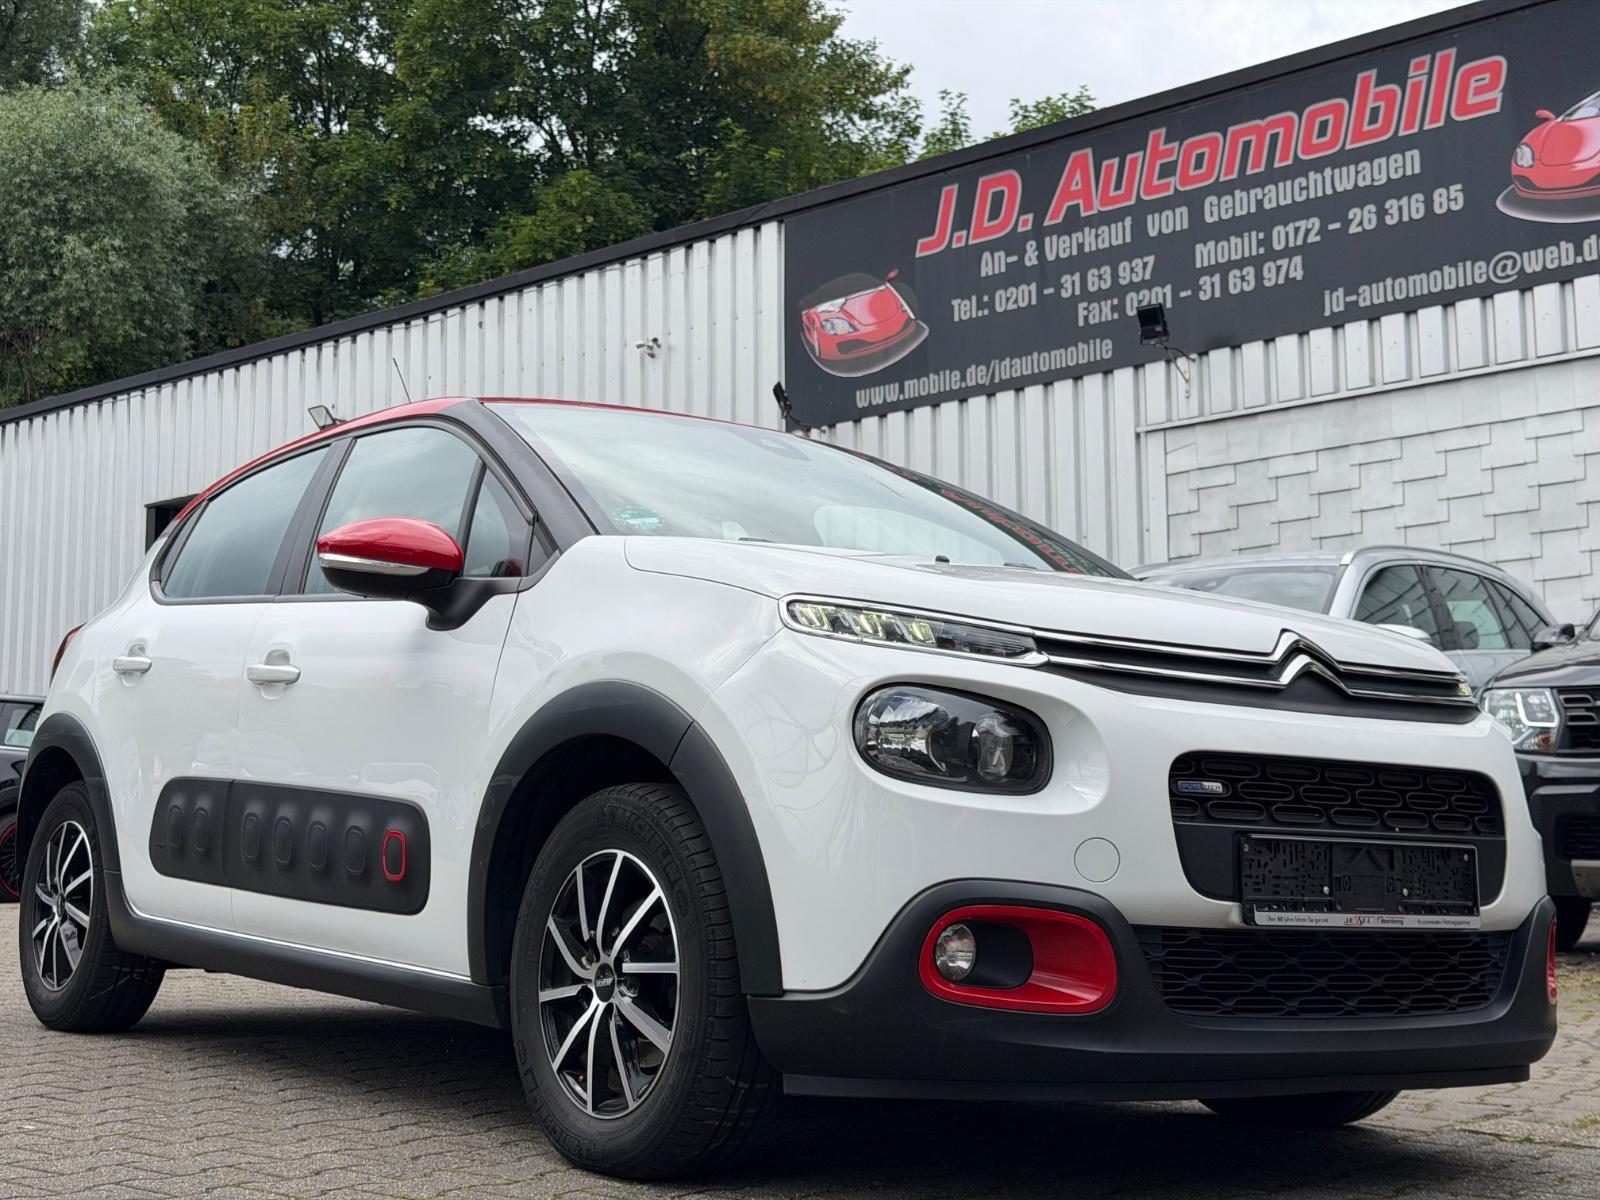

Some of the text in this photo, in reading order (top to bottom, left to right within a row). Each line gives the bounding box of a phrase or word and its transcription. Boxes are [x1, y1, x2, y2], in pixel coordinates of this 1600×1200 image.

[915, 46, 1507, 258] J.D. Automobile
[980, 149, 1421, 277] An- & Verkauf von Gebrauchtwagen
[1195, 231, 1265, 268] Mobil:
[1272, 217, 1321, 251] 0172
[1348, 204, 1377, 234] 26
[1384, 193, 1425, 225] 316
[1433, 183, 1464, 214] 85
[951, 294, 989, 322] Tel.:
[995, 282, 1037, 313] 0201
[1060, 272, 1081, 298] 31
[1087, 265, 1112, 292] 63
[1118, 255, 1155, 285] 937
[1077, 297, 1119, 327] Fax:
[1125, 284, 1172, 317] 0201
[1199, 273, 1221, 301] 31
[1228, 266, 1256, 295] 63
[1262, 255, 1304, 288] 974
[1323, 234, 1600, 316] jd-automobile@web.d
[856, 338, 1113, 408] www.mobile.de/jdautomobile
